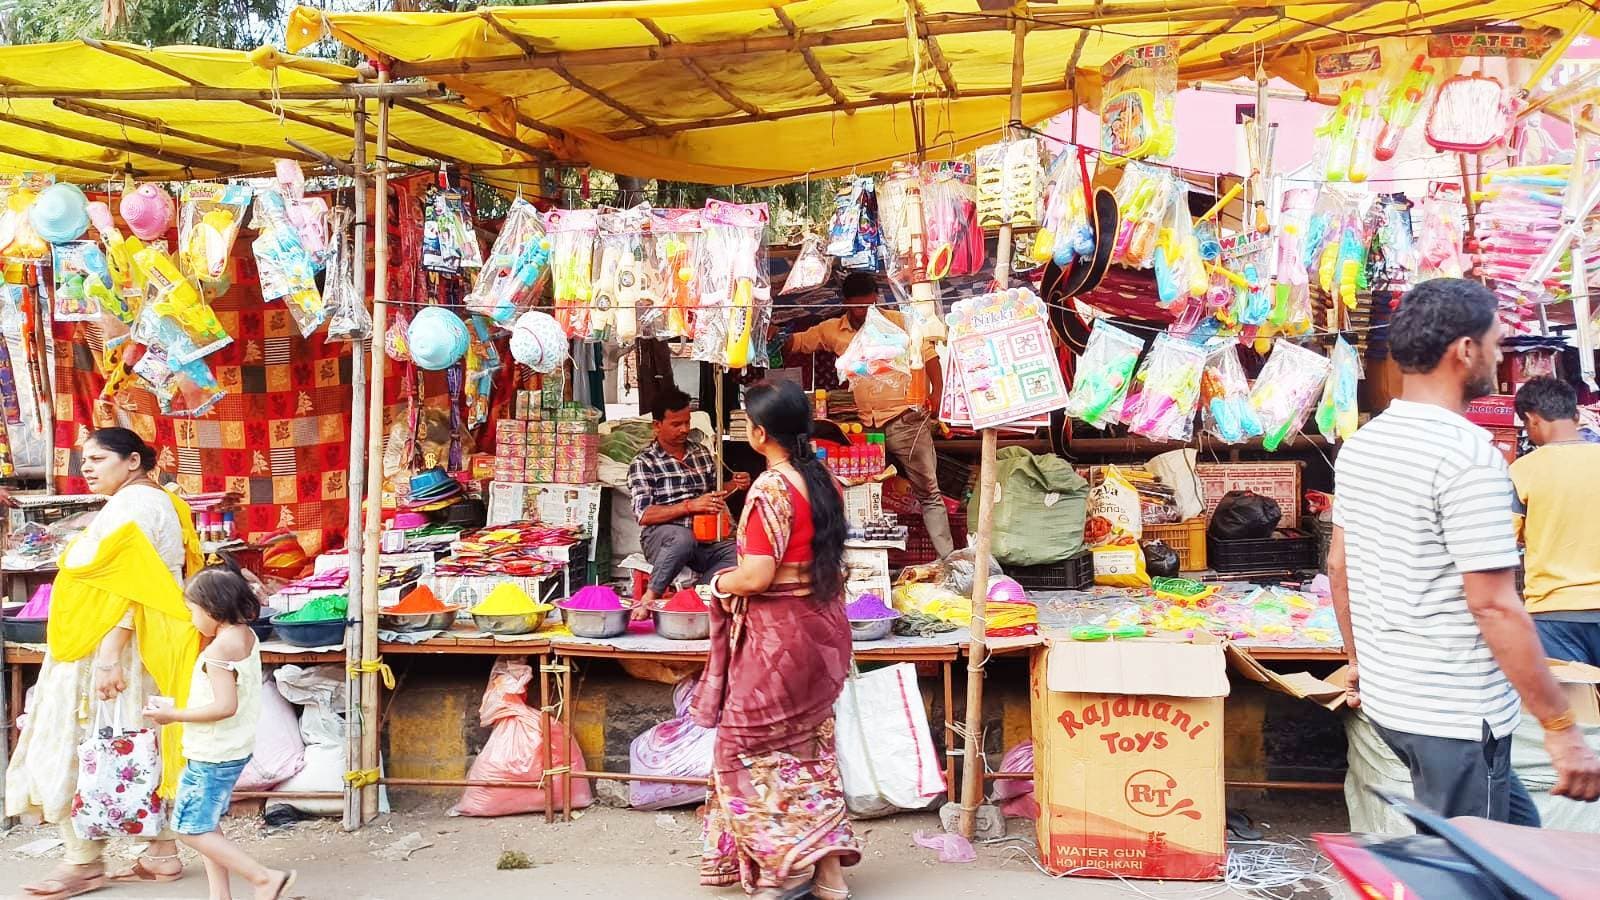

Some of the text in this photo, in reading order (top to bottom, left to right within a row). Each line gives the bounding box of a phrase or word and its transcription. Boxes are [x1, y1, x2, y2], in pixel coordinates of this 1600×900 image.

[1451, 34, 1527, 48] WATER
[1110, 45, 1167, 68] WATER
[929, 160, 972, 174] WATER
[972, 309, 1015, 328] Nikki
[1131, 785, 1172, 808] RT
[1056, 845, 1146, 858] WATER GUN
[1086, 860, 1143, 869] PICHKARI
